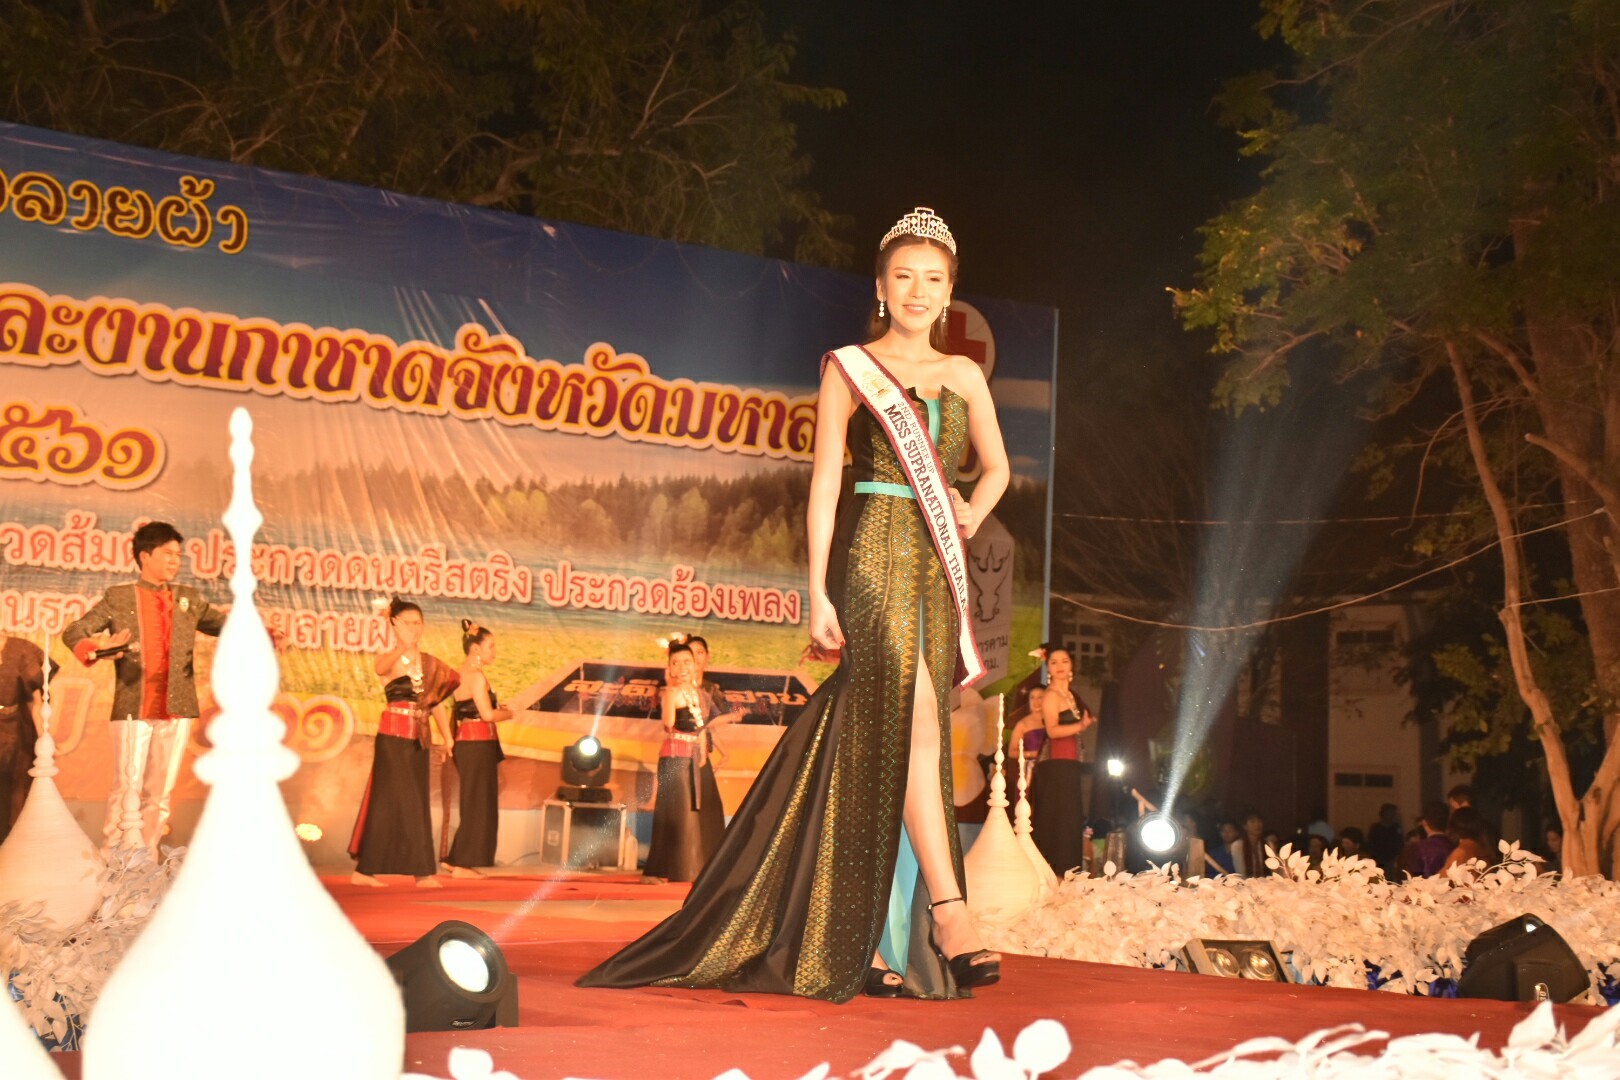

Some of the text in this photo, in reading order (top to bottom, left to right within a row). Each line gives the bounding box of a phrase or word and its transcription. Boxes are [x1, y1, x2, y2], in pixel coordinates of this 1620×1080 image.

[0, 168, 248, 254] ลายผ้า
[883, 403, 912, 439] MISS
[903, 439, 954, 555] SUPRANATIONAL
[910, 421, 930, 461] RUNNER
[926, 461, 935, 474] UP
[544, 564, 798, 621] ประกวดร้องเพลง
